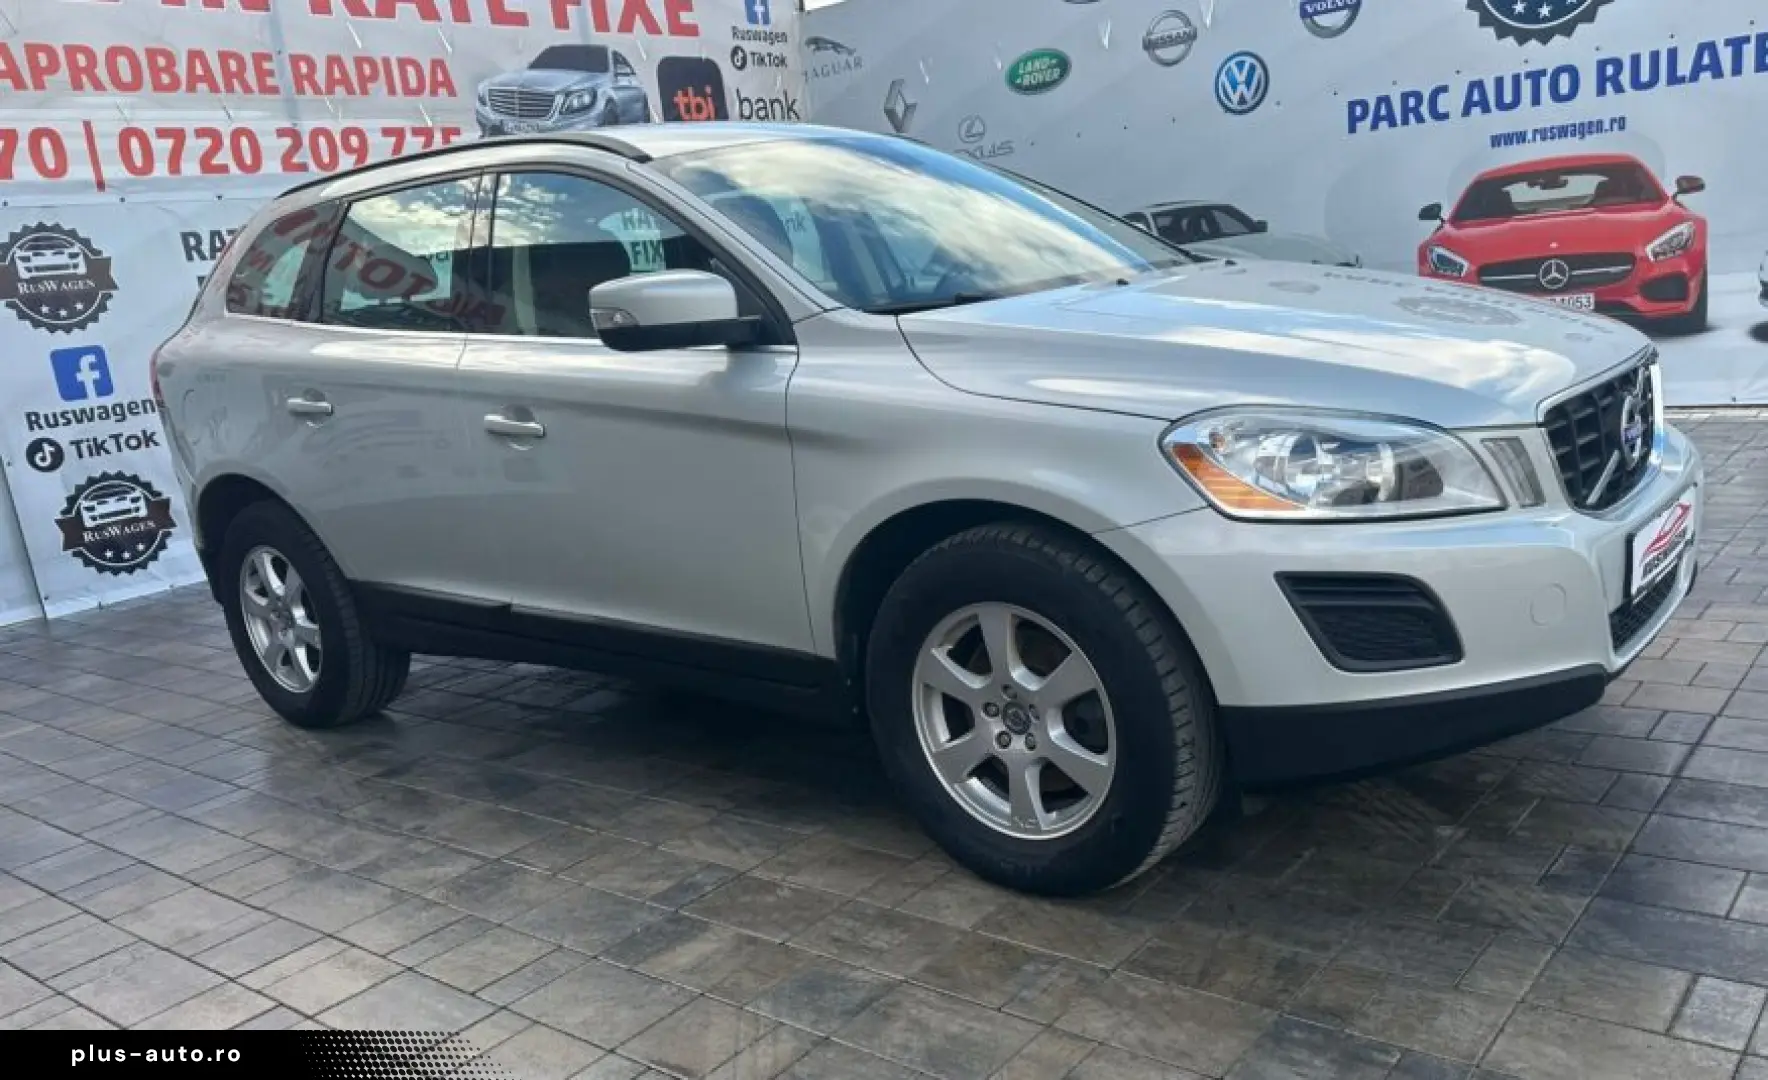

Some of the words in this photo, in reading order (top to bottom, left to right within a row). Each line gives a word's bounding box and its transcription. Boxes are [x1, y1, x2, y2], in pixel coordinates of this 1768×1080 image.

[732, 25, 788, 46] Ruswagen
[0, 42, 280, 94] APROBARE
[289, 53, 457, 98] RAPIDA
[750, 51, 788, 68] TikTok
[801, 55, 863, 82] JAGUAR
[1347, 83, 1450, 134] PARC
[1461, 63, 1580, 118] AUTO
[1595, 31, 1768, 98] RULATE
[673, 85, 717, 120] tbi
[736, 87, 801, 121] bank
[1490, 114, 1627, 149] www.ruswagen.ro
[118, 125, 263, 176] 0720
[275, 126, 371, 173] 209
[25, 398, 156, 432] Ruswagen
[69, 429, 160, 460] TikTok
